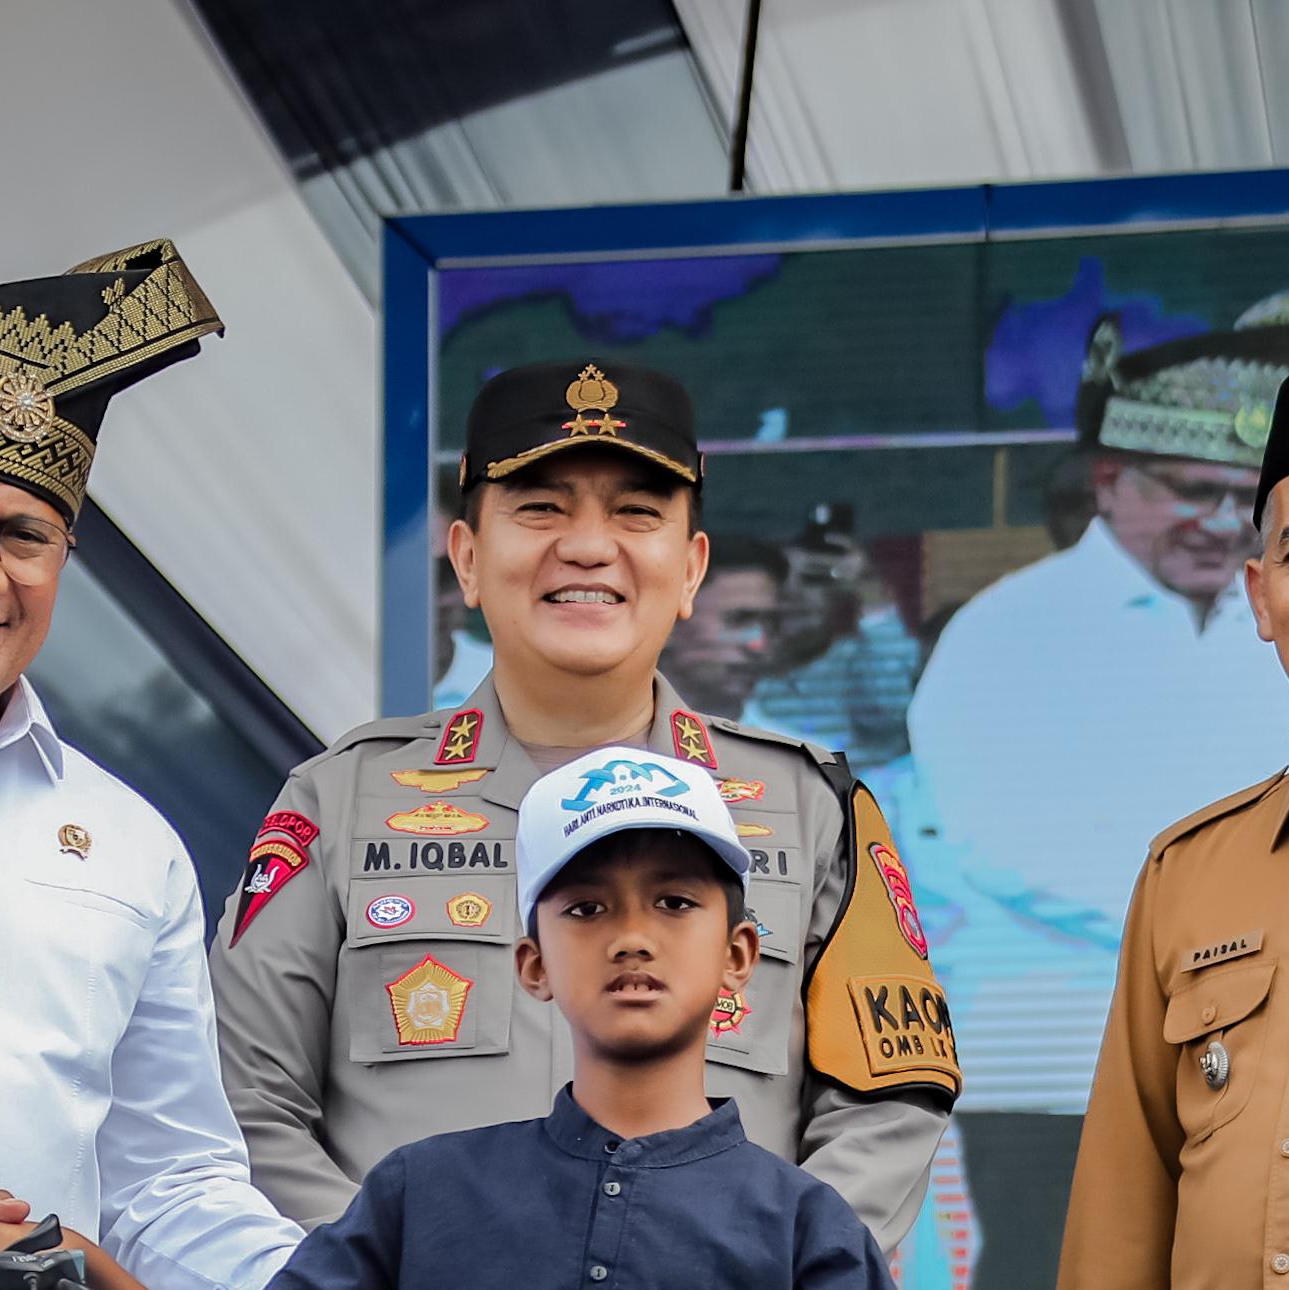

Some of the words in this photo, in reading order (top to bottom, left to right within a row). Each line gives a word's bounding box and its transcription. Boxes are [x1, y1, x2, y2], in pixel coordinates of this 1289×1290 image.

[610, 783, 641, 796] 2024
[363, 841, 401, 872] M.
[409, 841, 508, 871] IQBAL
[1193, 938, 1247, 962] PAISAL
[879, 1034, 925, 1059] OMB
